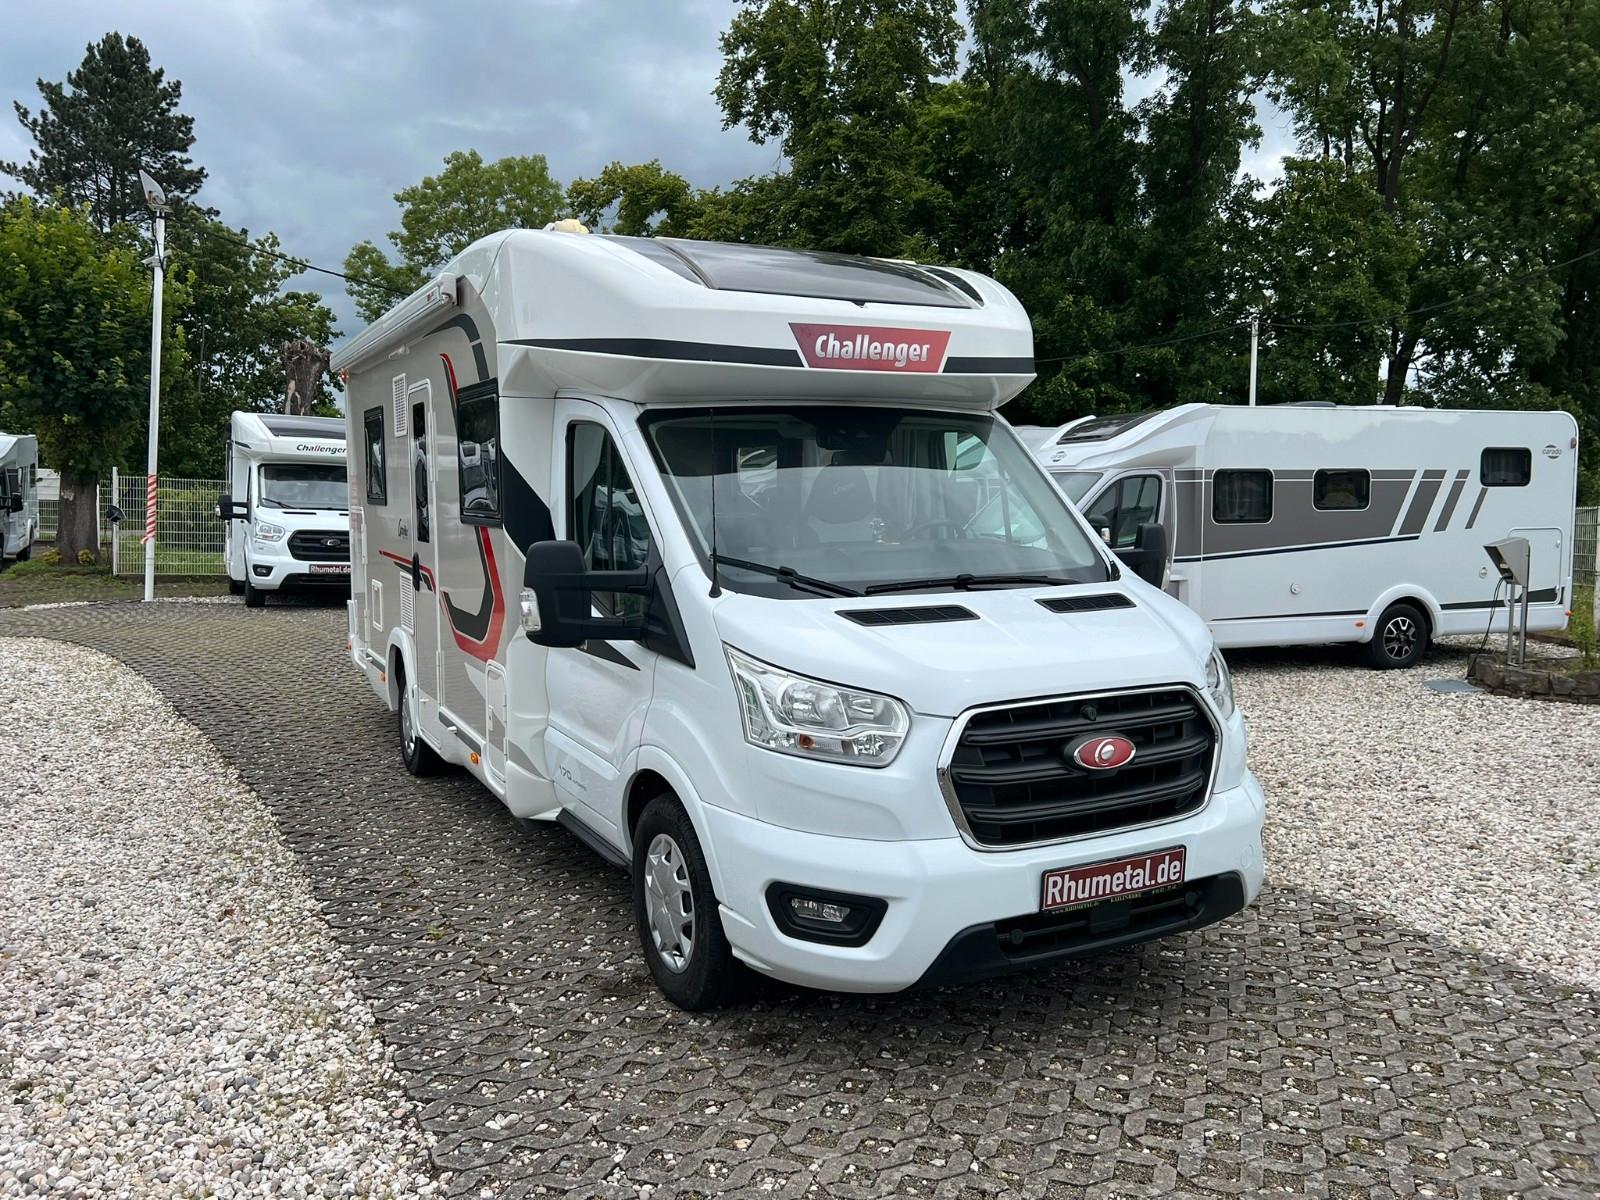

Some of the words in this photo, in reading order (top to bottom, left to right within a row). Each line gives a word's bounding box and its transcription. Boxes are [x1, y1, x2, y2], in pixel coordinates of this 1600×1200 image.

[815, 332, 930, 368] Challenger
[296, 443, 347, 455] Challenger
[310, 565, 351, 573] Rhumetal.de
[1047, 855, 1181, 904] Rhumetal.de
